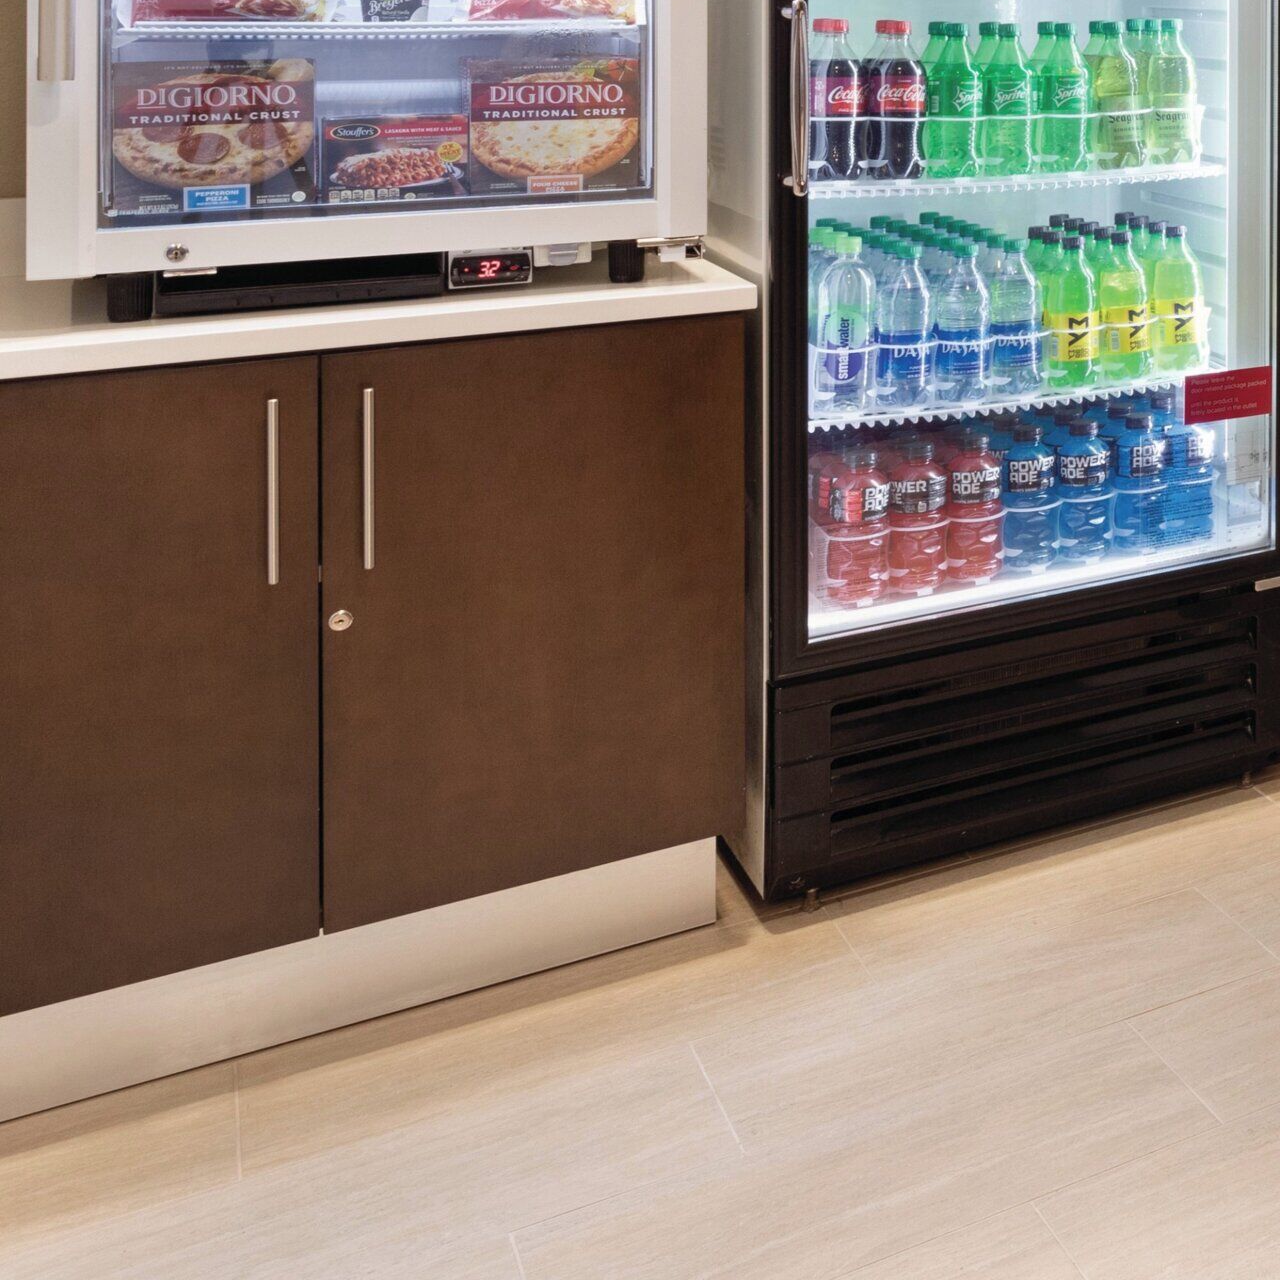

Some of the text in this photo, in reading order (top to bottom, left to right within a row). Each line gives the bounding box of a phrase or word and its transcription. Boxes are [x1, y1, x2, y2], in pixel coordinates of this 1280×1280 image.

[136, 84, 297, 109] DIGIORNO
[489, 83, 624, 106] DIGIORNO
[129, 110, 302, 125] TRADITIONAL CRUST
[483, 107, 627, 119] TRADITIONAL CRUST
[335, 126, 376, 139] Stouffer's
[194, 189, 240, 197] PEPPERONI
[1008, 456, 1056, 472] POWER
[1059, 454, 1103, 469] POWER
[952, 469, 1000, 485] POWER
[1008, 472, 1038, 485] ADE
[952, 483, 981, 496] ADE
